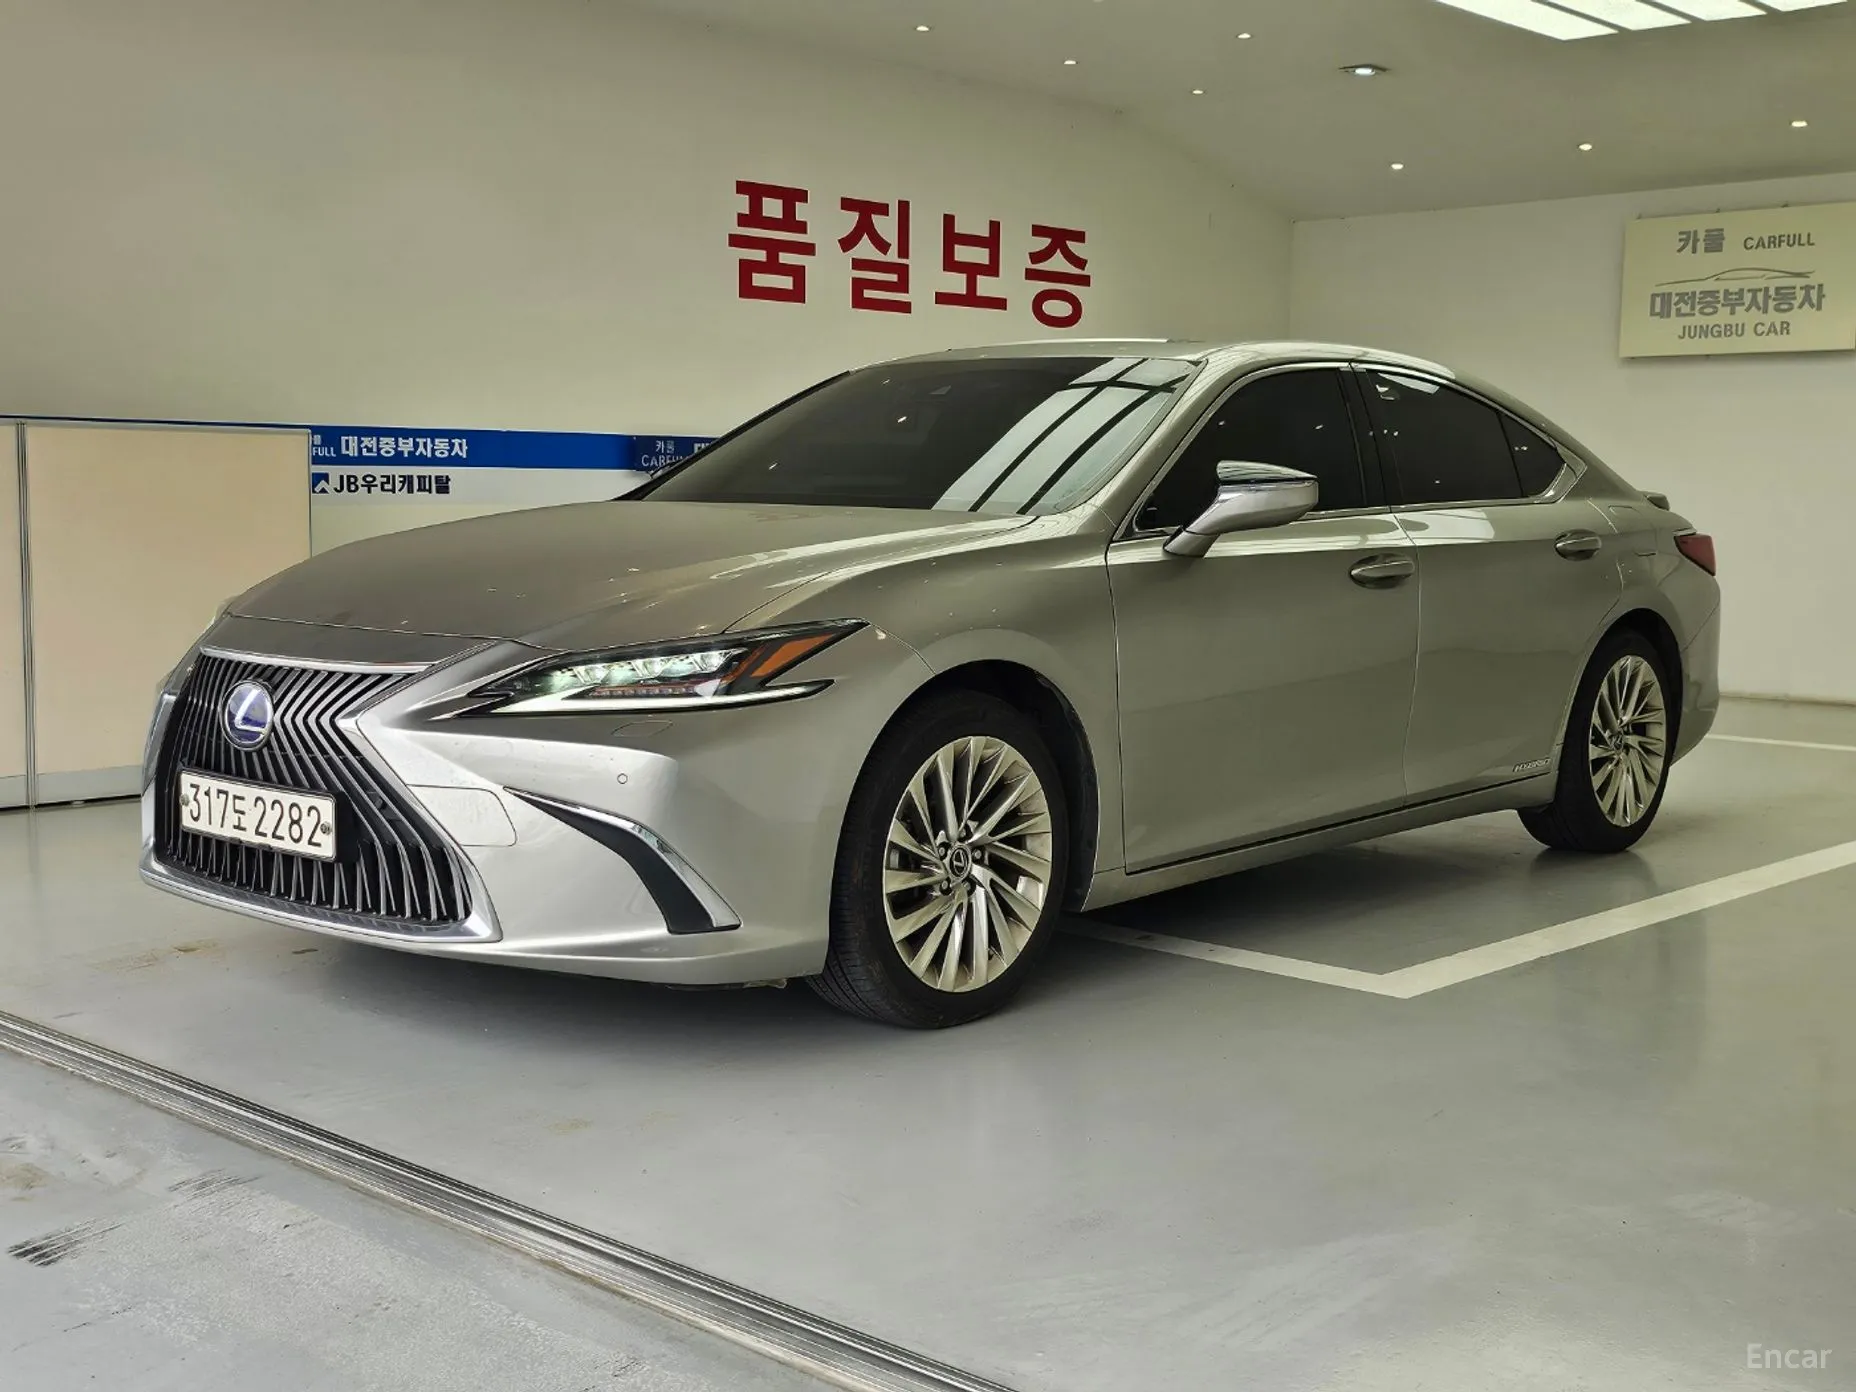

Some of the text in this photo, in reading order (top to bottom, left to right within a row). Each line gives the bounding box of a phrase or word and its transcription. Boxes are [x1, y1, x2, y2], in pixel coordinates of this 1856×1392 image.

[1743, 232, 1815, 251] CARFULL
[728, 180, 1091, 328] 품질보증
[1650, 283, 1826, 319] 대전중부자동차
[1678, 320, 1790, 340] JUNGBU CAR
[340, 435, 468, 459] 대전중부자동차
[333, 473, 451, 495] JB우리캐피탈
